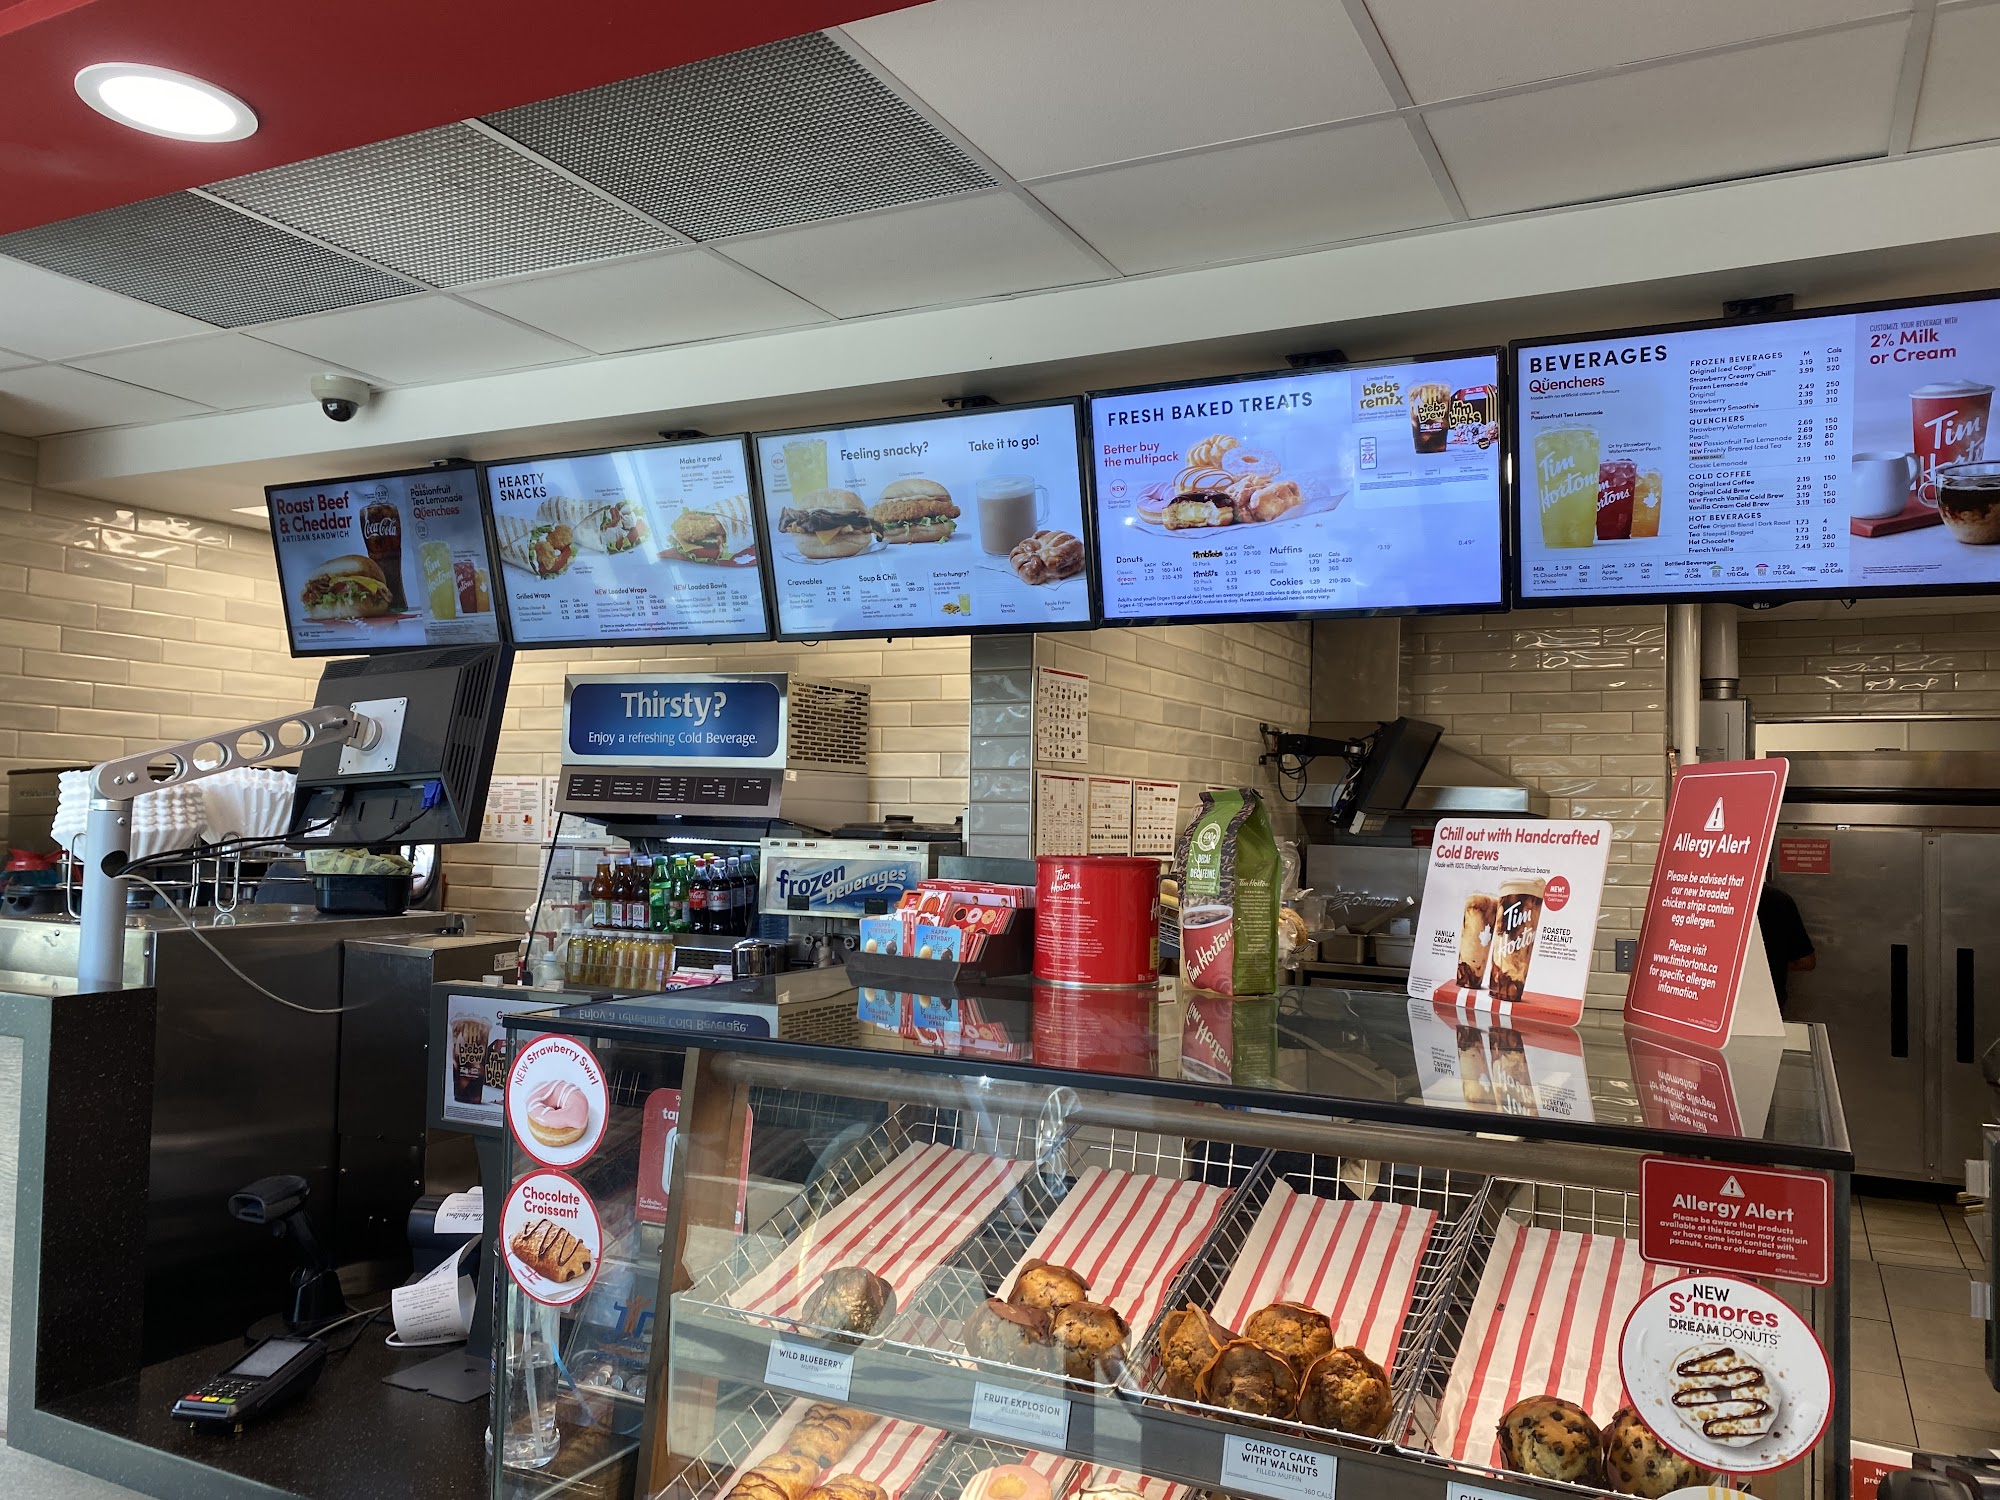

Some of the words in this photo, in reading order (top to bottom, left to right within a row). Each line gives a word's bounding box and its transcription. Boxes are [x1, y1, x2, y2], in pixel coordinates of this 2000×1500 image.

[1871, 333, 1894, 347] 2%
[1900, 328, 1939, 345] Milk
[1530, 345, 1667, 373] BEVERAGES
[1691, 358, 1725, 366] FROZEN
[1729, 352, 1783, 363] BEVERAGES
[1870, 353, 1888, 364] or
[1893, 347, 1956, 363] Cream
[1363, 381, 1400, 396] biebs
[1107, 408, 1163, 427] FRESH
[1171, 400, 1233, 420] BAKED
[1240, 391, 1313, 413] TREATS
[1360, 393, 1404, 409] remix
[1690, 416, 1745, 425] QUENCHERS
[841, 447, 880, 460] Feeling
[883, 442, 929, 458] snacky?
[968, 439, 994, 452] Take
[997, 438, 1004, 449] it
[1007, 437, 1018, 448] to
[1021, 435, 1039, 450] go!
[1104, 444, 1137, 454] Better
[1140, 442, 1159, 453] buy
[708, 454, 722, 462] meal
[1104, 458, 1121, 467] the
[1124, 452, 1178, 466] multipack
[498, 473, 544, 488] HEARTY
[1717, 471, 1751, 479] COFFEE
[411, 485, 450, 496] Passionfruit
[501, 486, 546, 501] SNACKS
[277, 496, 315, 515] Roast
[318, 492, 349, 508] Beef
[412, 497, 424, 505] Tea
[427, 495, 462, 505] Lemonade
[280, 518, 289, 534] &
[293, 512, 352, 532] Cheddar
[1710, 512, 1762, 520] BEVERAGES
[282, 533, 309, 543] ARTISAN
[311, 531, 349, 540] SANDWICH
[1270, 546, 1302, 554] Muffins
[788, 578, 822, 586] Craveables
[859, 574, 874, 582] Soup
[947, 570, 969, 578] hungry?
[1270, 578, 1303, 586] Cookies
[534, 592, 550, 600] Wraps
[620, 690, 727, 727] Thirsty?
[589, 732, 615, 746] Enjoy
[619, 734, 624, 743] a
[628, 732, 675, 747] refreshing
[678, 732, 701, 744] Cold
[706, 733, 758, 746] Beverage.
[1440, 827, 1463, 841] Chill
[1466, 830, 1484, 841] out
[1488, 829, 1512, 843] with
[1515, 828, 1600, 845] Handcrafted
[1436, 845, 1461, 859] Cold
[1464, 846, 1499, 861] Brews
[1674, 834, 1718, 858] Allergy
[1719, 834, 1751, 855] Alert
[776, 865, 845, 898] frozen
[1055, 869, 1070, 880] Tim
[1667, 869, 1689, 883] Please
[1690, 873, 1698, 883] be
[1699, 874, 1727, 886] advised
[1728, 875, 1744, 886] that
[826, 868, 907, 904] beverages
[1051, 882, 1080, 893] Hortons
[1672, 888, 1682, 897] our
[1684, 889, 1698, 897] new
[1699, 888, 1730, 899] breaded
[1662, 899, 1686, 909] chicken
[1687, 901, 1706, 913] strips
[1707, 903, 1734, 915] contain
[1504, 901, 1531, 931] Tim
[1672, 915, 1684, 926] egg
[1686, 915, 1716, 929] allergen.
[1542, 927, 1570, 935] ROASTED
[1542, 934, 1573, 943] HAZELNUT
[1669, 940, 1691, 953] Please
[1692, 944, 1706, 955] visit
[1653, 954, 1717, 974] www.timhortons.ca
[1650, 964, 1659, 975] for
[1659, 967, 1685, 983] specific
[1686, 973, 1716, 989] allergen
[1658, 981, 1699, 1000] information.
[515, 1062, 529, 1086] NEW
[527, 1042, 580, 1065] Strawberry
[580, 1056, 599, 1086] Swirl
[523, 1186, 580, 1205] Chocolate
[524, 1200, 578, 1218] Croissant
[1672, 1194, 1740, 1219] Allergy
[1745, 1203, 1794, 1222] Alert
[1660, 1220, 1695, 1230] available
[1708, 1225, 1722, 1234] this
[1724, 1227, 1755, 1237] location
[1758, 1233, 1775, 1242] may
[1777, 1235, 1807, 1245] contain
[1673, 1213, 1699, 1223] Please
[1701, 1216, 1710, 1224] be
[1739, 1221, 1755, 1229] that
[1758, 1225, 1793, 1235] products
[1683, 1230, 1701, 1239] have
[1704, 1234, 1725, 1242] come
[1727, 1235, 1742, 1244] into
[1744, 1239, 1774, 1248] contact
[1777, 1242, 1794, 1251] with
[1670, 1238, 1703, 1248] peanuts,
[1705, 1242, 1721, 1250] nuts
[1734, 1246, 1755, 1254] other
[1757, 1248, 1797, 1261] allergens.
[1693, 1284, 1729, 1301] NEW
[1669, 1292, 1778, 1327] S'mores
[1669, 1318, 1719, 1335] DREAM
[779, 1349, 798, 1360] WILD
[800, 1353, 843, 1370] BLUEBERRY
[984, 1392, 1008, 1405] FRUIT
[1010, 1397, 1060, 1416] EXPLOSION
[1245, 1442, 1287, 1458] CARROT
[1289, 1451, 1316, 1465] CAKE
[1241, 1453, 1267, 1467] WITH
[1270, 1458, 1318, 1477] WALNUTS
